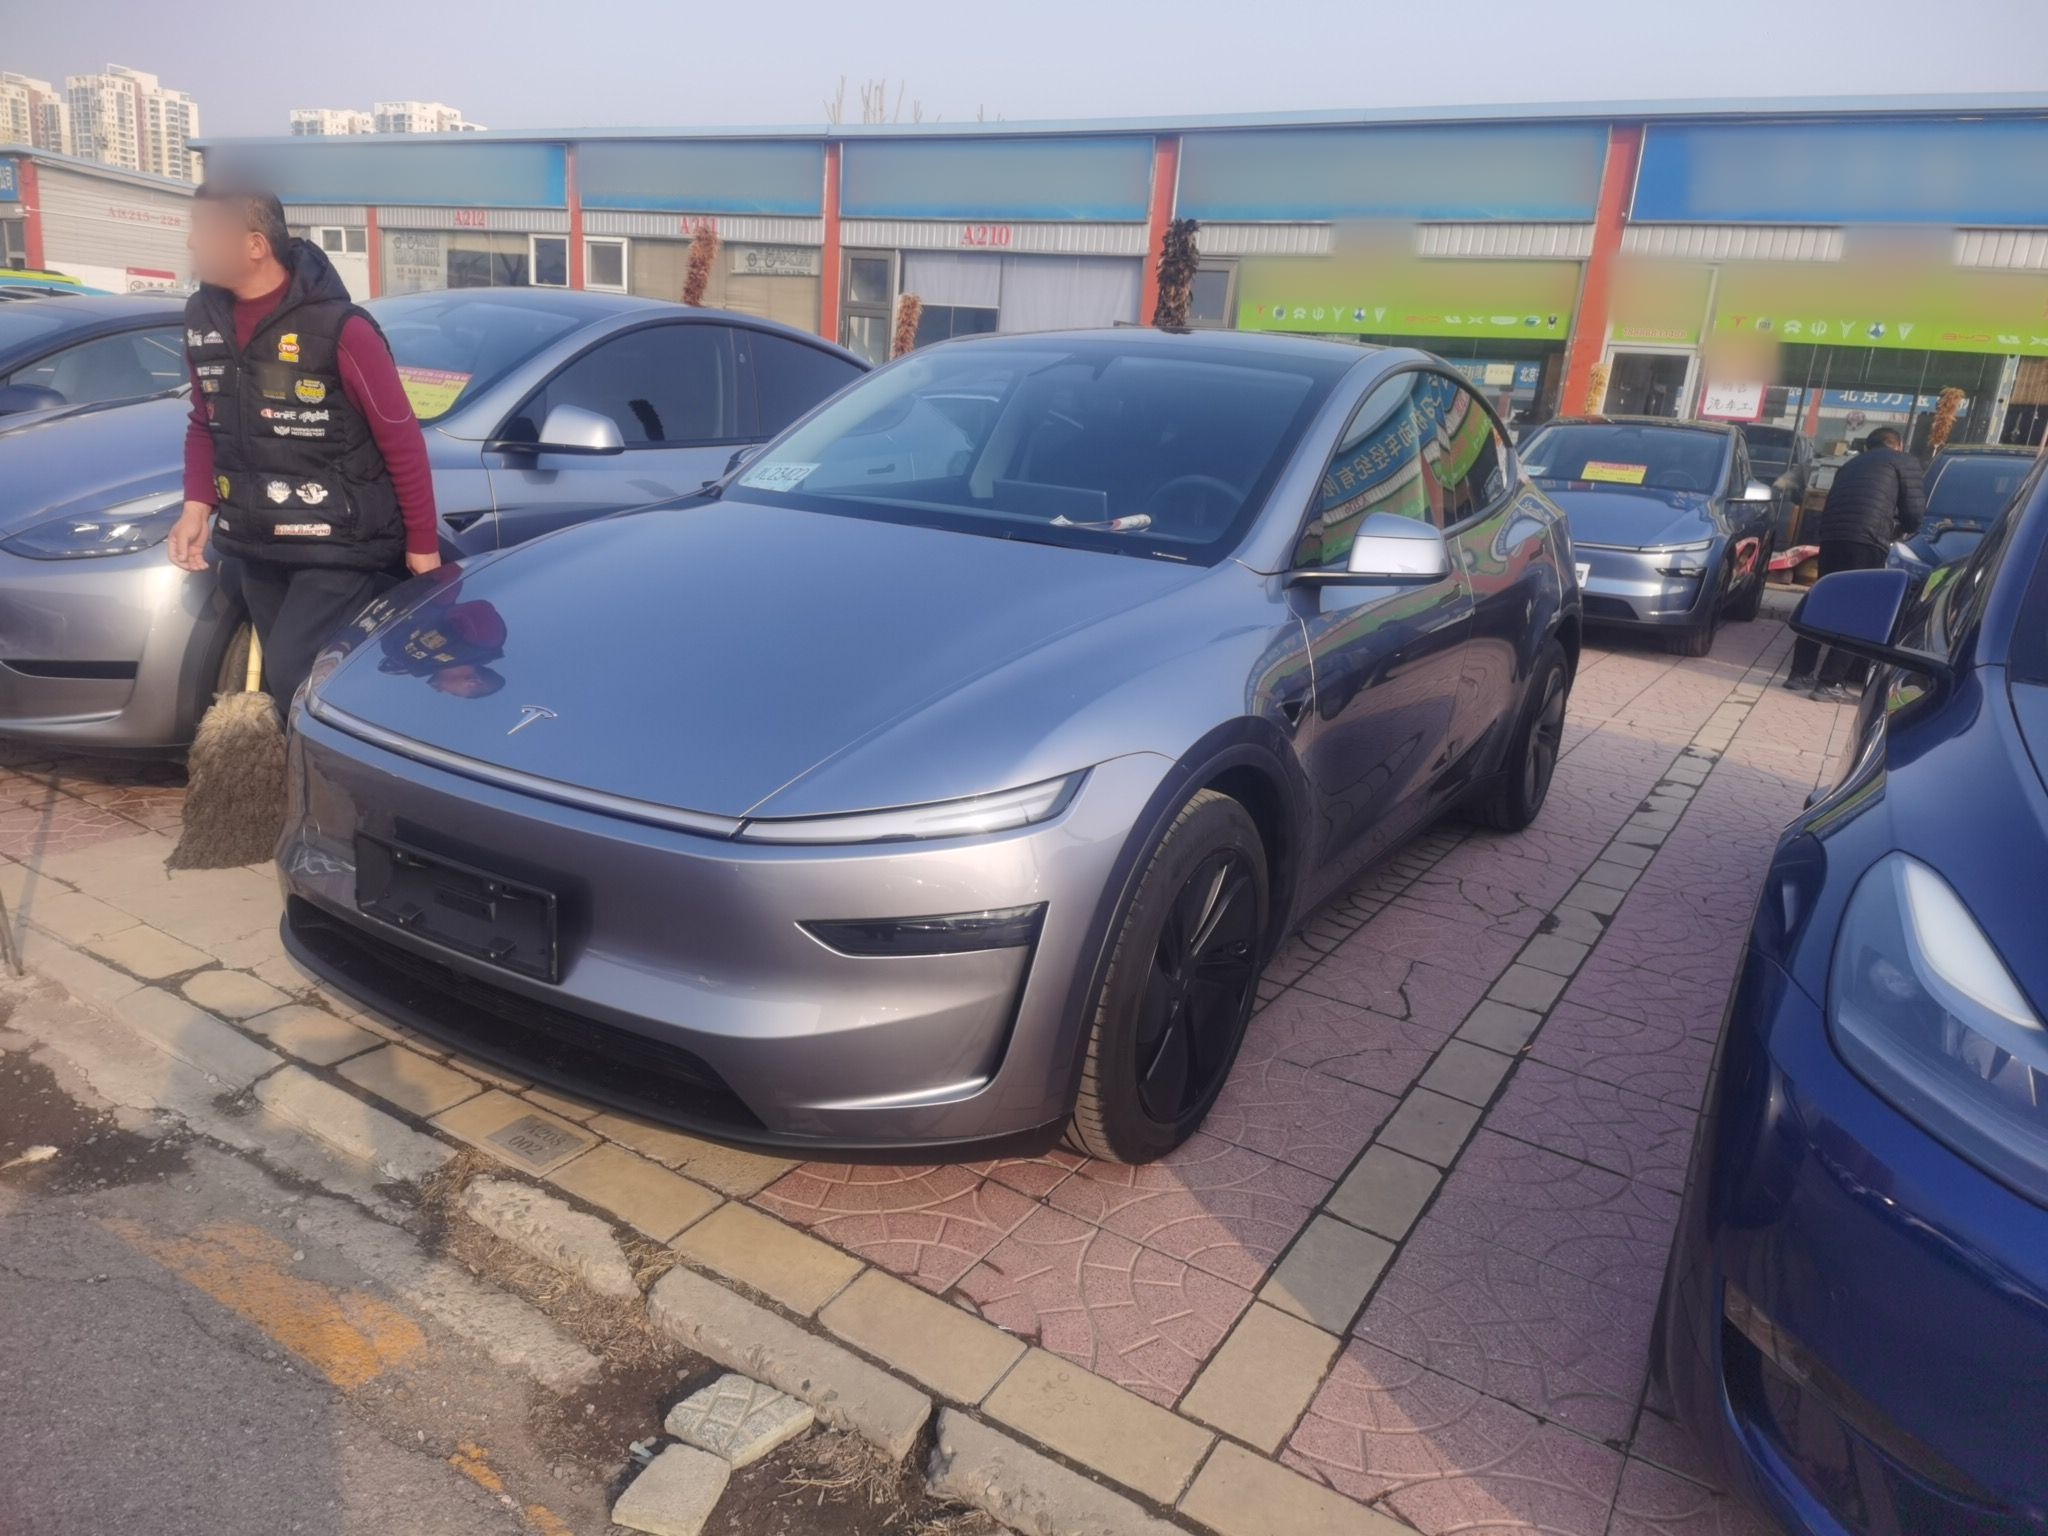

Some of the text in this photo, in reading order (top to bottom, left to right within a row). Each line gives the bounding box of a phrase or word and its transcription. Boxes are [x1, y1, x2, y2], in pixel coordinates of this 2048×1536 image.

[454, 209, 486, 227] A212
[961, 225, 1011, 247] A210
[508, 1134, 543, 1156] 002
